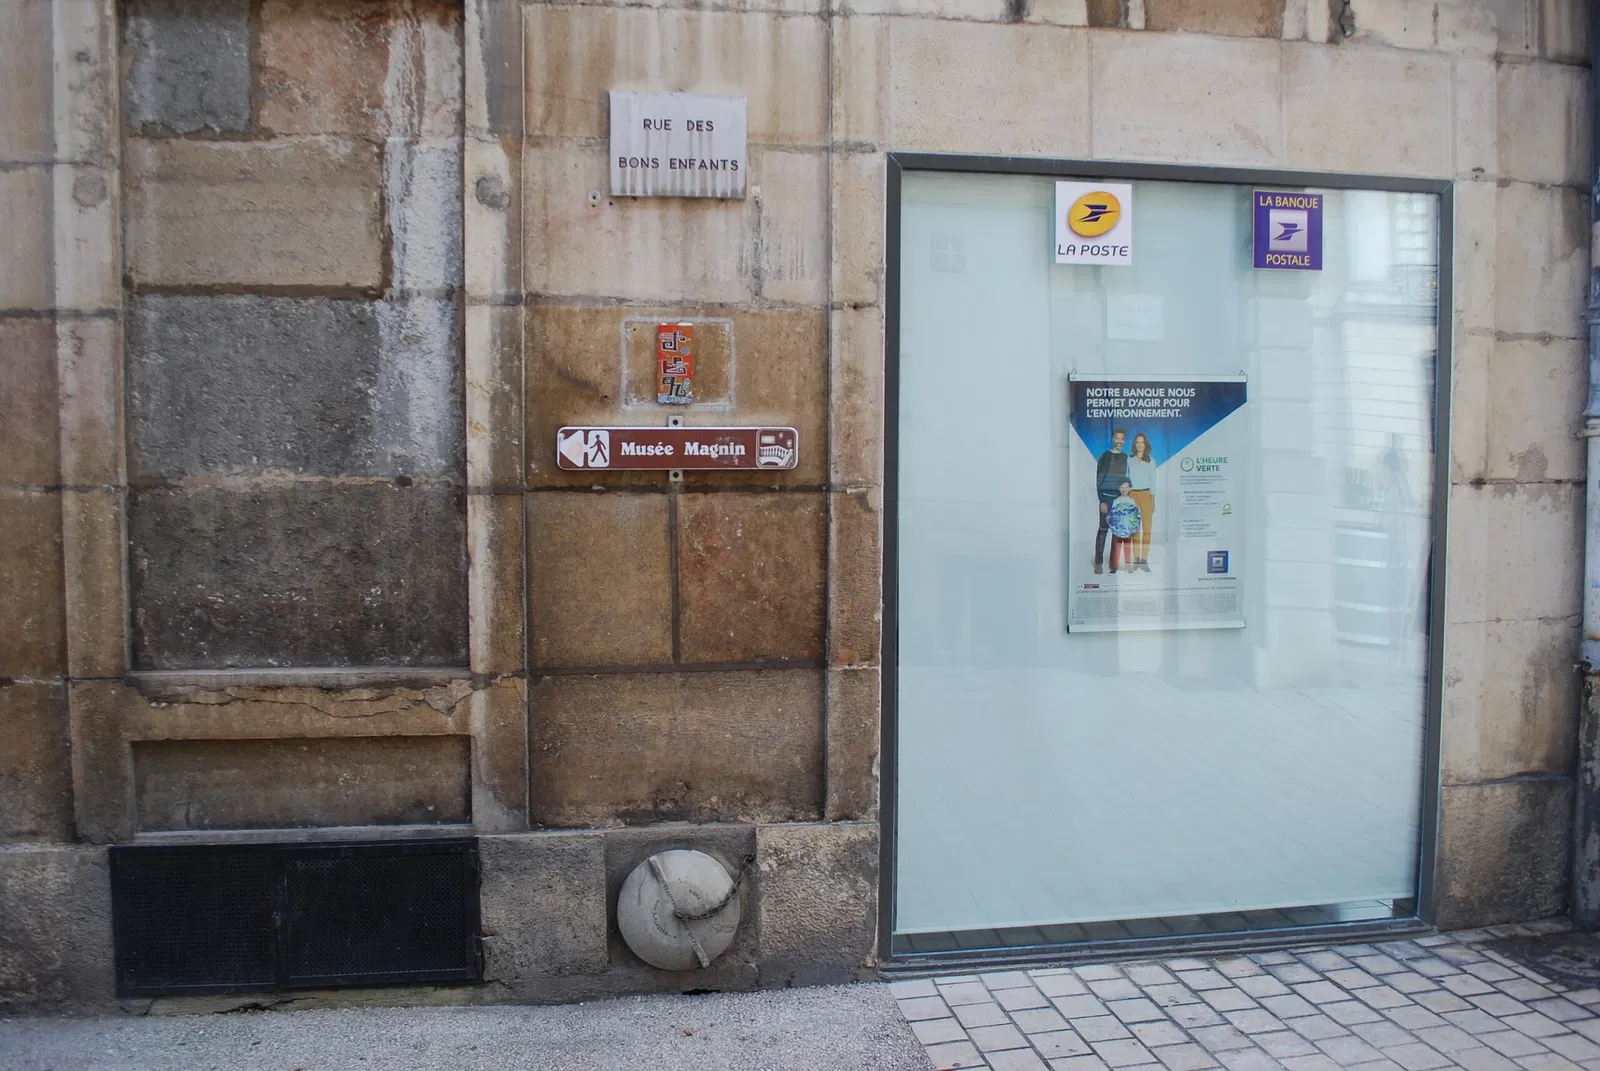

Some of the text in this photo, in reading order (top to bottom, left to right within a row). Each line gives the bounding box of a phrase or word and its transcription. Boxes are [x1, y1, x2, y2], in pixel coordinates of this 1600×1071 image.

[643, 118, 714, 132] RUE DES
[618, 157, 739, 171] BONS ENFANTS
[1260, 196, 1319, 209] LA BANQUE
[1058, 245, 1129, 257] LA POSTE
[1266, 254, 1311, 266] POSTALE
[1086, 388, 1196, 397] NOTRE BANQUE NOUS
[1086, 398, 1190, 407] PERMET D'AGIR POUR
[1086, 409, 1182, 418] L'ENVIRONNEMENT.
[620, 441, 746, 458] Musée Magnin
